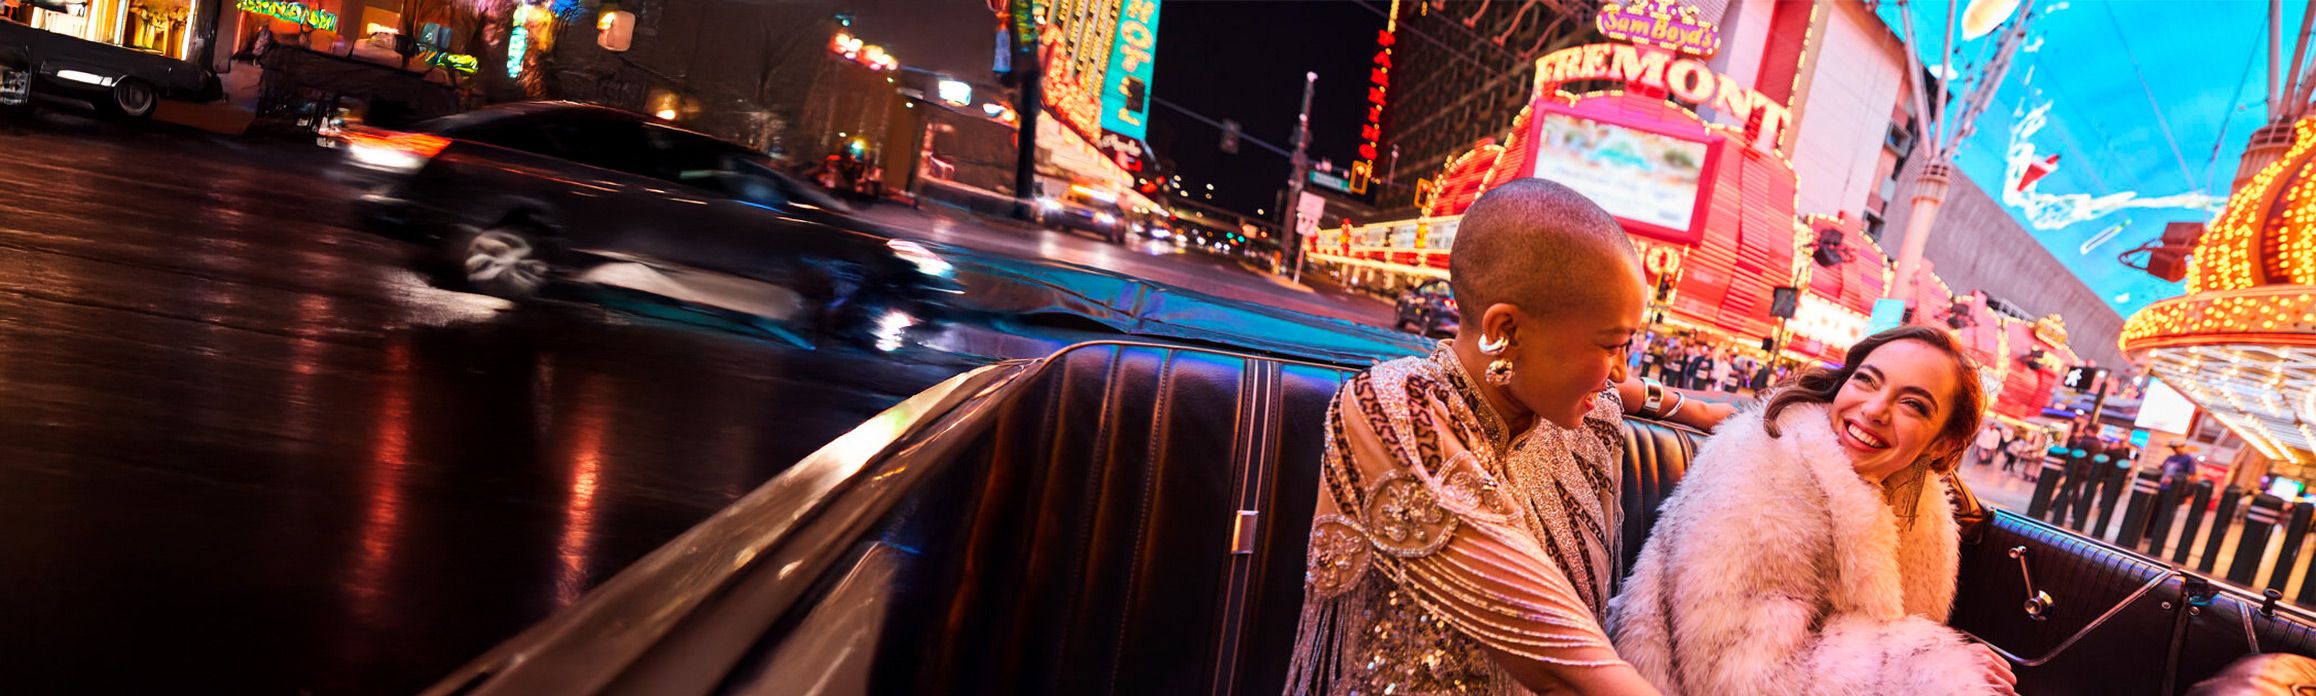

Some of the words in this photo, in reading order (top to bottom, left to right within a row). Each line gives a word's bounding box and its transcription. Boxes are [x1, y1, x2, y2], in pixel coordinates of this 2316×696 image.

[1604, 12, 1650, 36] Sam
[1651, 18, 1713, 47] Boyd's
[1536, 42, 1792, 152] FREMONT
